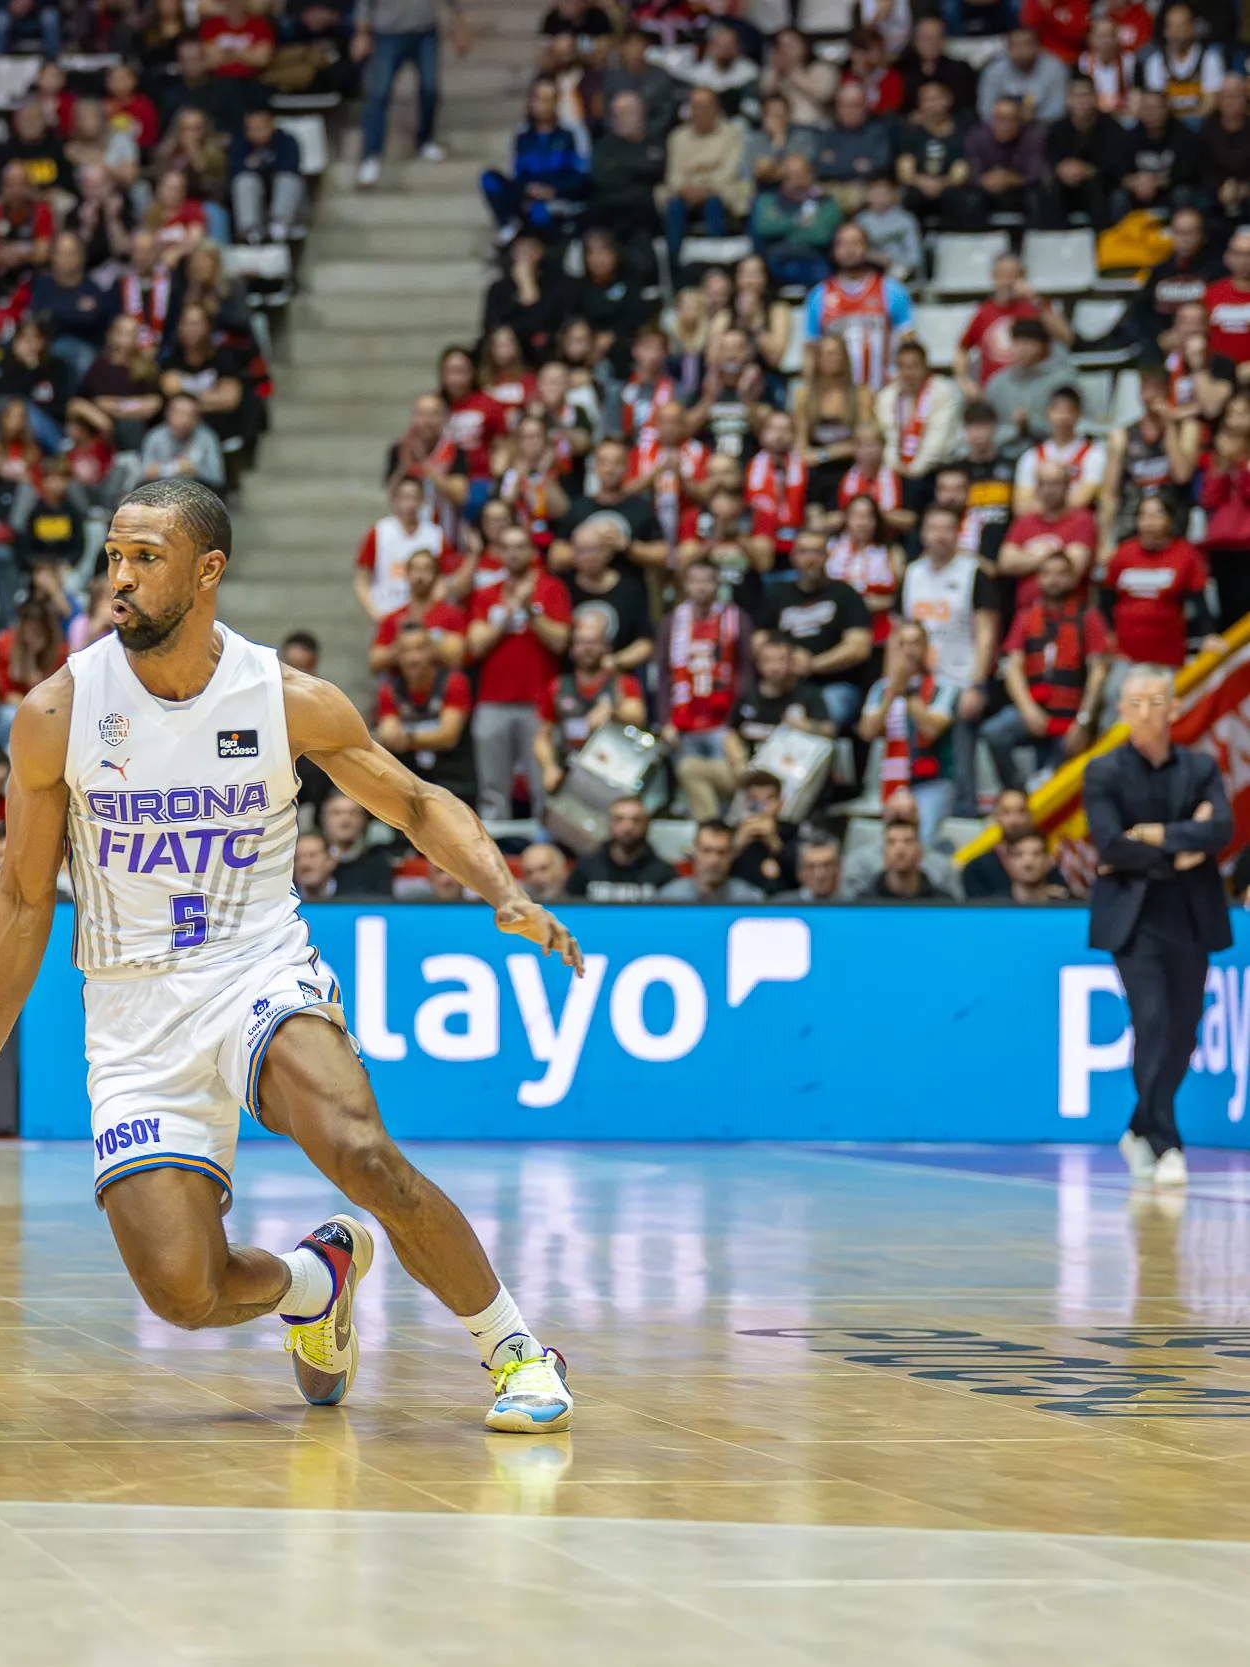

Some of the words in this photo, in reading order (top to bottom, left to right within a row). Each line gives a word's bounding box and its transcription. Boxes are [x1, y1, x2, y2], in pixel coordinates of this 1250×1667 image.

[100, 730, 128, 739] GIRONA
[220, 739, 237, 748] liga
[220, 747, 257, 756] endesa
[85, 781, 269, 825] GIRONA
[98, 827, 265, 874] FIATC
[169, 893, 209, 950] 5
[248, 1016, 267, 1036] Costa
[355, 915, 708, 1108] layo
[95, 1118, 160, 1160] YOSOY
